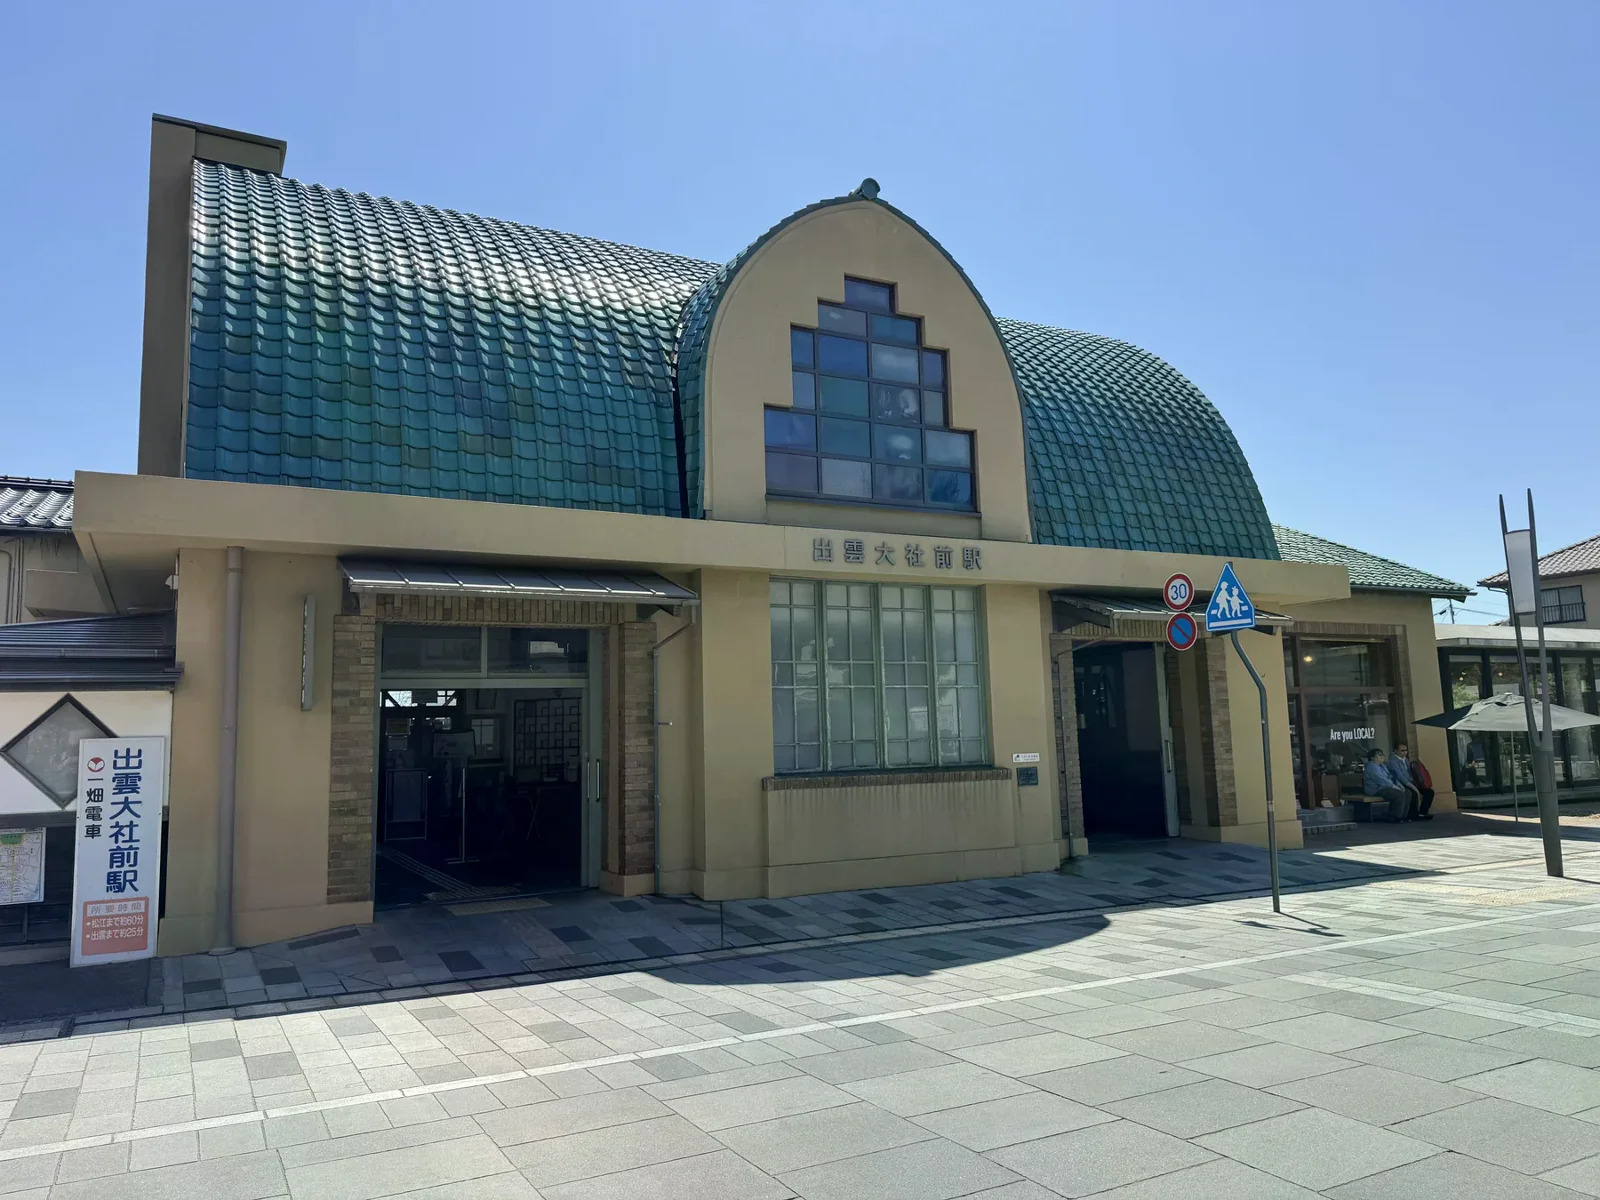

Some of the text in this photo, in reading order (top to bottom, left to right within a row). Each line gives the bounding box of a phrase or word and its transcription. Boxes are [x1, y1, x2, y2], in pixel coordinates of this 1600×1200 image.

[812, 537, 983, 570] 出雲大社前駅
[1170, 583, 1188, 600] 30
[1330, 727, 1375, 743] Are you LOCAL?
[84, 777, 104, 840] 一畑電車
[105, 747, 143, 894] 出雲大社前駅
[90, 901, 142, 915] 所要時間
